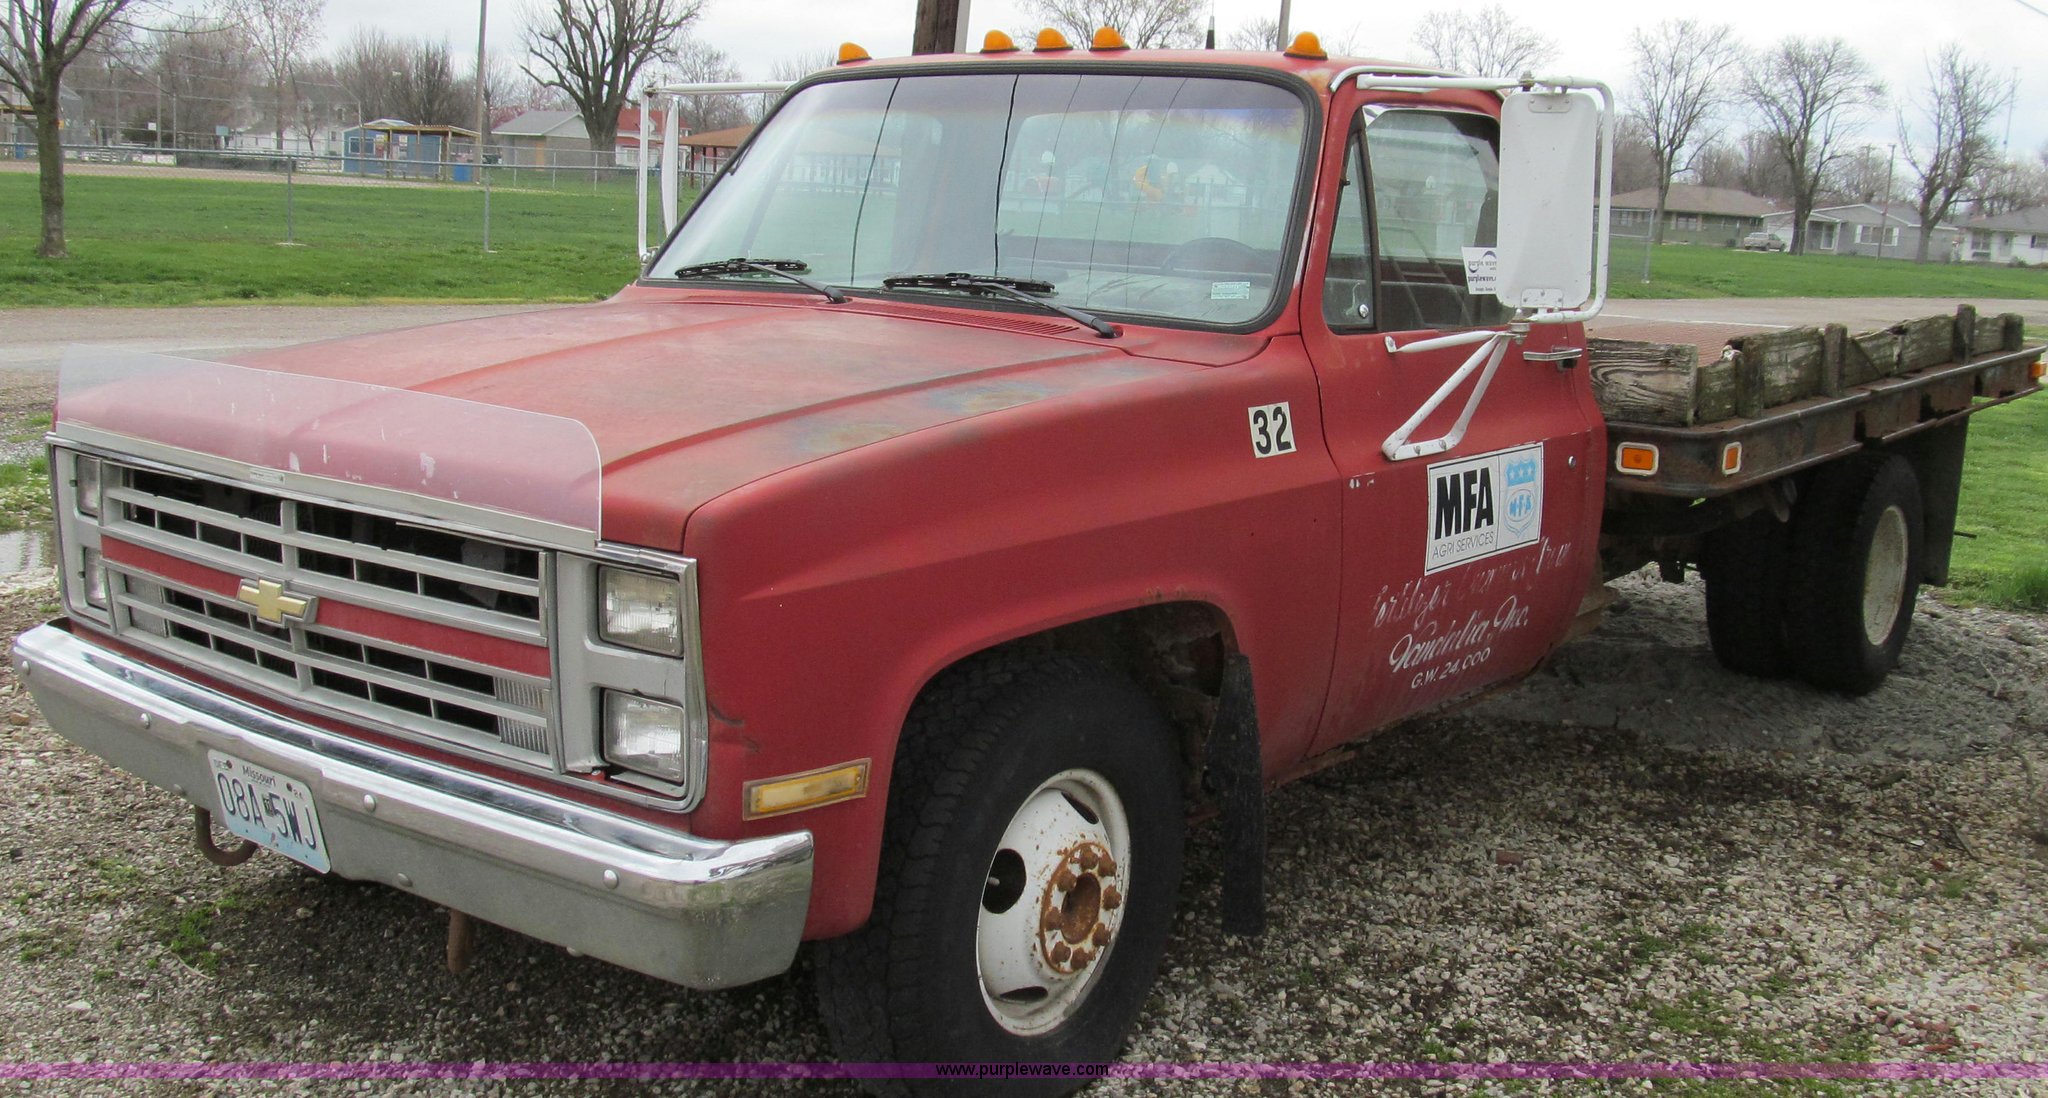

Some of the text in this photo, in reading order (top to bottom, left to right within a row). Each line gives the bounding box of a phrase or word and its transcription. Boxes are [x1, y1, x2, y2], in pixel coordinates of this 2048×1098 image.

[1253, 406, 1292, 455] 32
[1435, 467, 1494, 540] MFA
[1432, 531, 1494, 560] AGRI SERVICES
[1439, 647, 1491, 680] 24,000
[242, 765, 276, 787] Missouri
